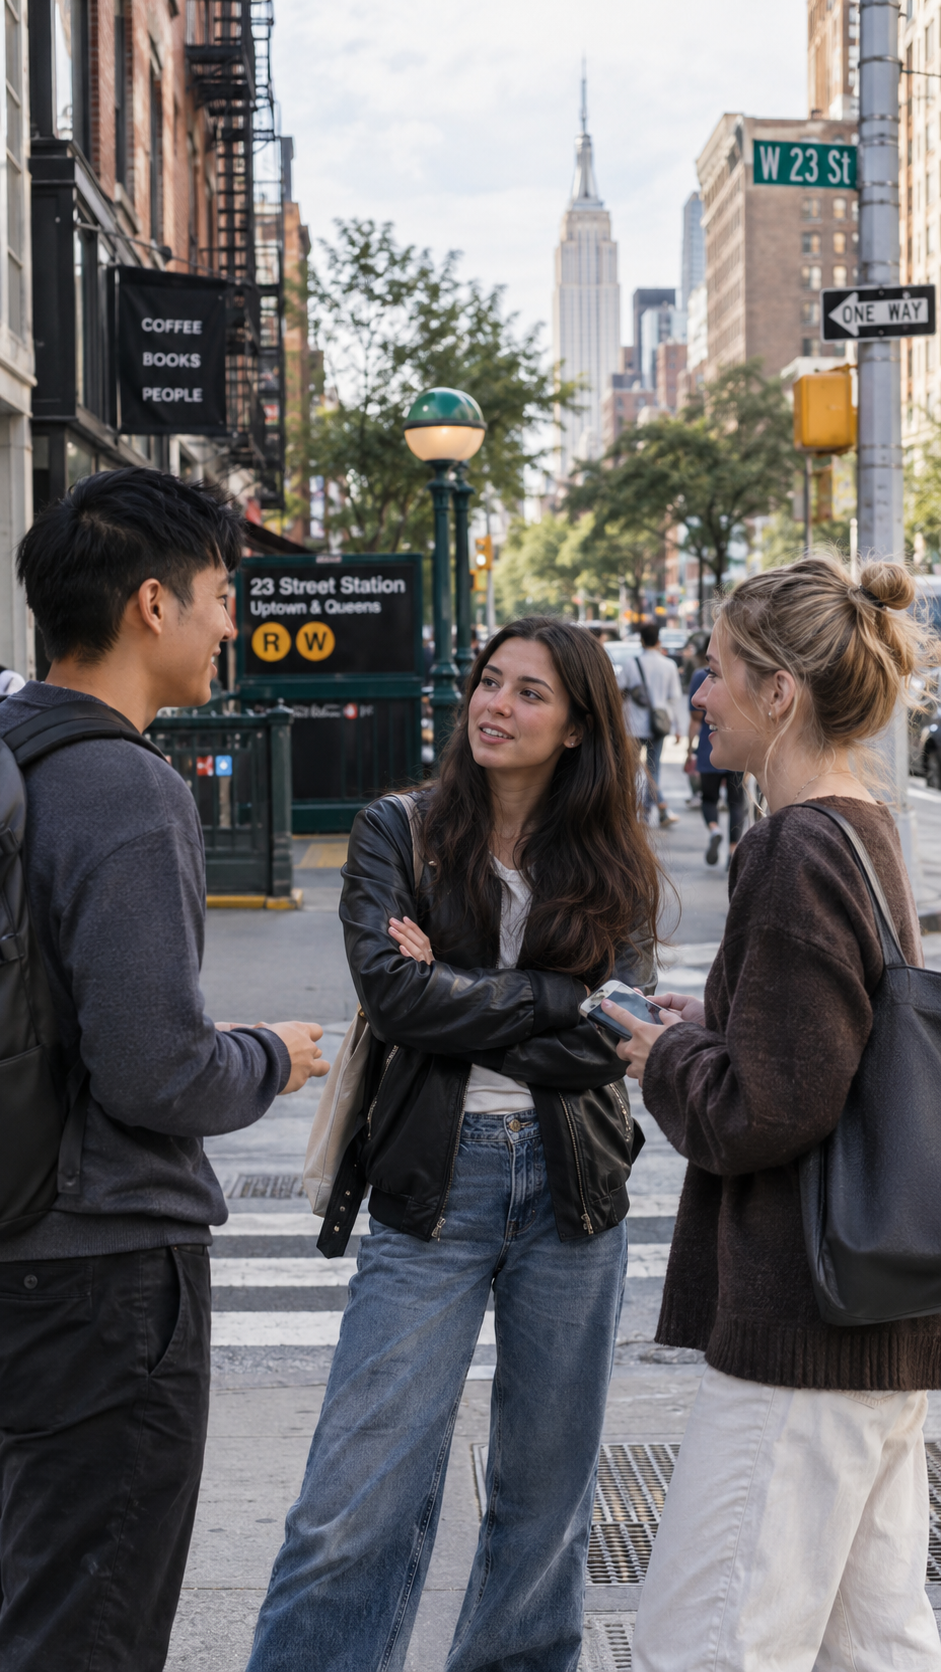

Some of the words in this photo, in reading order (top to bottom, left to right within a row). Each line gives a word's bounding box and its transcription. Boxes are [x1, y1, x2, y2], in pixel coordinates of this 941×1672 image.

[760, 145, 780, 181] W
[789, 147, 819, 183] 23
[828, 149, 852, 185] St
[842, 305, 875, 324] ONE
[888, 301, 923, 321] WAY
[141, 317, 203, 335] COFFEE
[142, 352, 201, 368] BOOKS
[142, 387, 203, 402] PEOPLE
[250, 577, 275, 596] 23
[279, 577, 336, 595] Street
[340, 575, 406, 594] Station
[250, 600, 307, 618] Uptown
[310, 599, 322, 615] &
[324, 599, 382, 615] Queens
[263, 632, 280, 652] R
[303, 631, 327, 651] W
